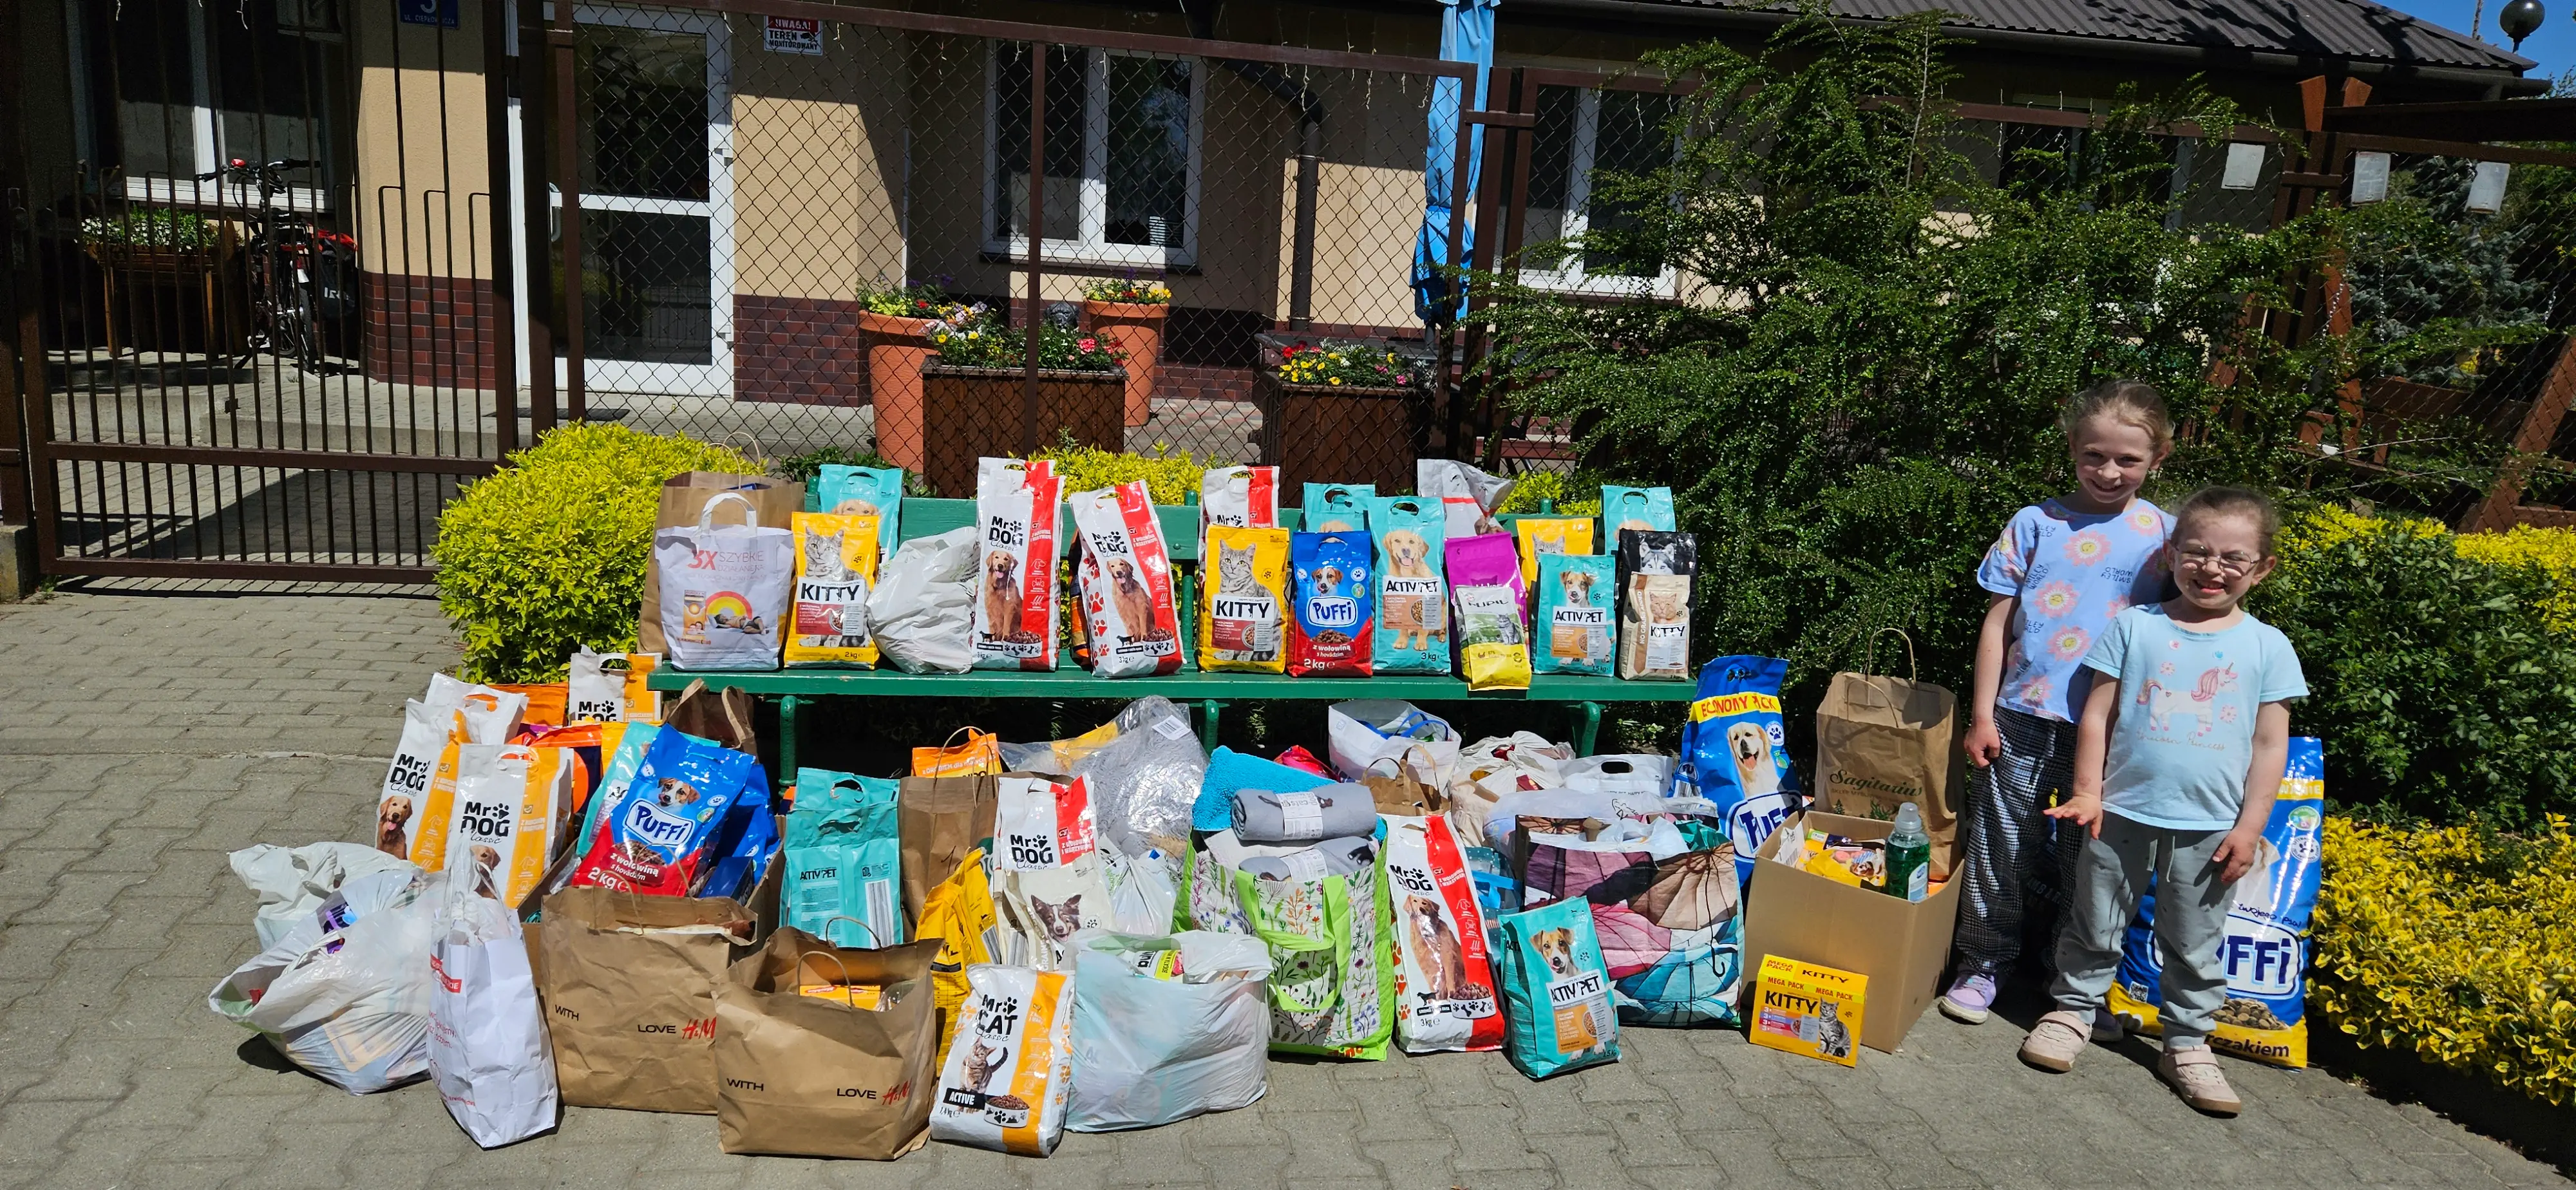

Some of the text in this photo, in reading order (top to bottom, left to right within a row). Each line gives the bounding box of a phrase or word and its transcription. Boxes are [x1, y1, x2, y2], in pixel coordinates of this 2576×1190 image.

[769, 30, 797, 41] TEREN
[770, 39, 818, 50] MONITOROWANY
[992, 516, 1009, 529] Mr
[988, 527, 1023, 546] DOG
[687, 549, 718, 571] 3X
[800, 583, 860, 602] KITTY
[1216, 600, 1270, 618] KITTY
[1428, 652, 1437, 661] kg
[1303, 658, 1325, 671] 2 kg
[578, 702, 600, 712] Mr
[397, 753, 422, 770] Mr
[390, 766, 426, 791] DOG
[1830, 769, 1923, 797] Sagitarius
[464, 801, 491, 816] Mr
[460, 815, 511, 837] DOG
[470, 830, 503, 844] lassic
[1010, 834, 1032, 847] Mr
[1011, 846, 1054, 864] DOG
[587, 866, 618, 889] 2 kg
[1389, 864, 1408, 877] Mr
[1395, 875, 1434, 891] DOG
[1766, 963, 1792, 972] PACK
[1767, 959, 1793, 968] MEGA
[1767, 976, 1804, 990] MEGA PACK
[1802, 969, 1850, 983] KITTY
[1815, 987, 1853, 1001] MEGA PACK
[981, 994, 1003, 1013] Mr
[1765, 990, 1818, 1014] KITTY
[554, 1004, 580, 1021] WITH
[638, 1015, 717, 1040] LOVE H&M
[976, 1009, 1018, 1035] CAT
[1420, 1018, 1425, 1026] 3
[2203, 1034, 2290, 1057] rczakiem
[726, 1077, 764, 1091] WITH
[837, 1088, 876, 1100] LOVE
[949, 1091, 976, 1106] ACTIVE
